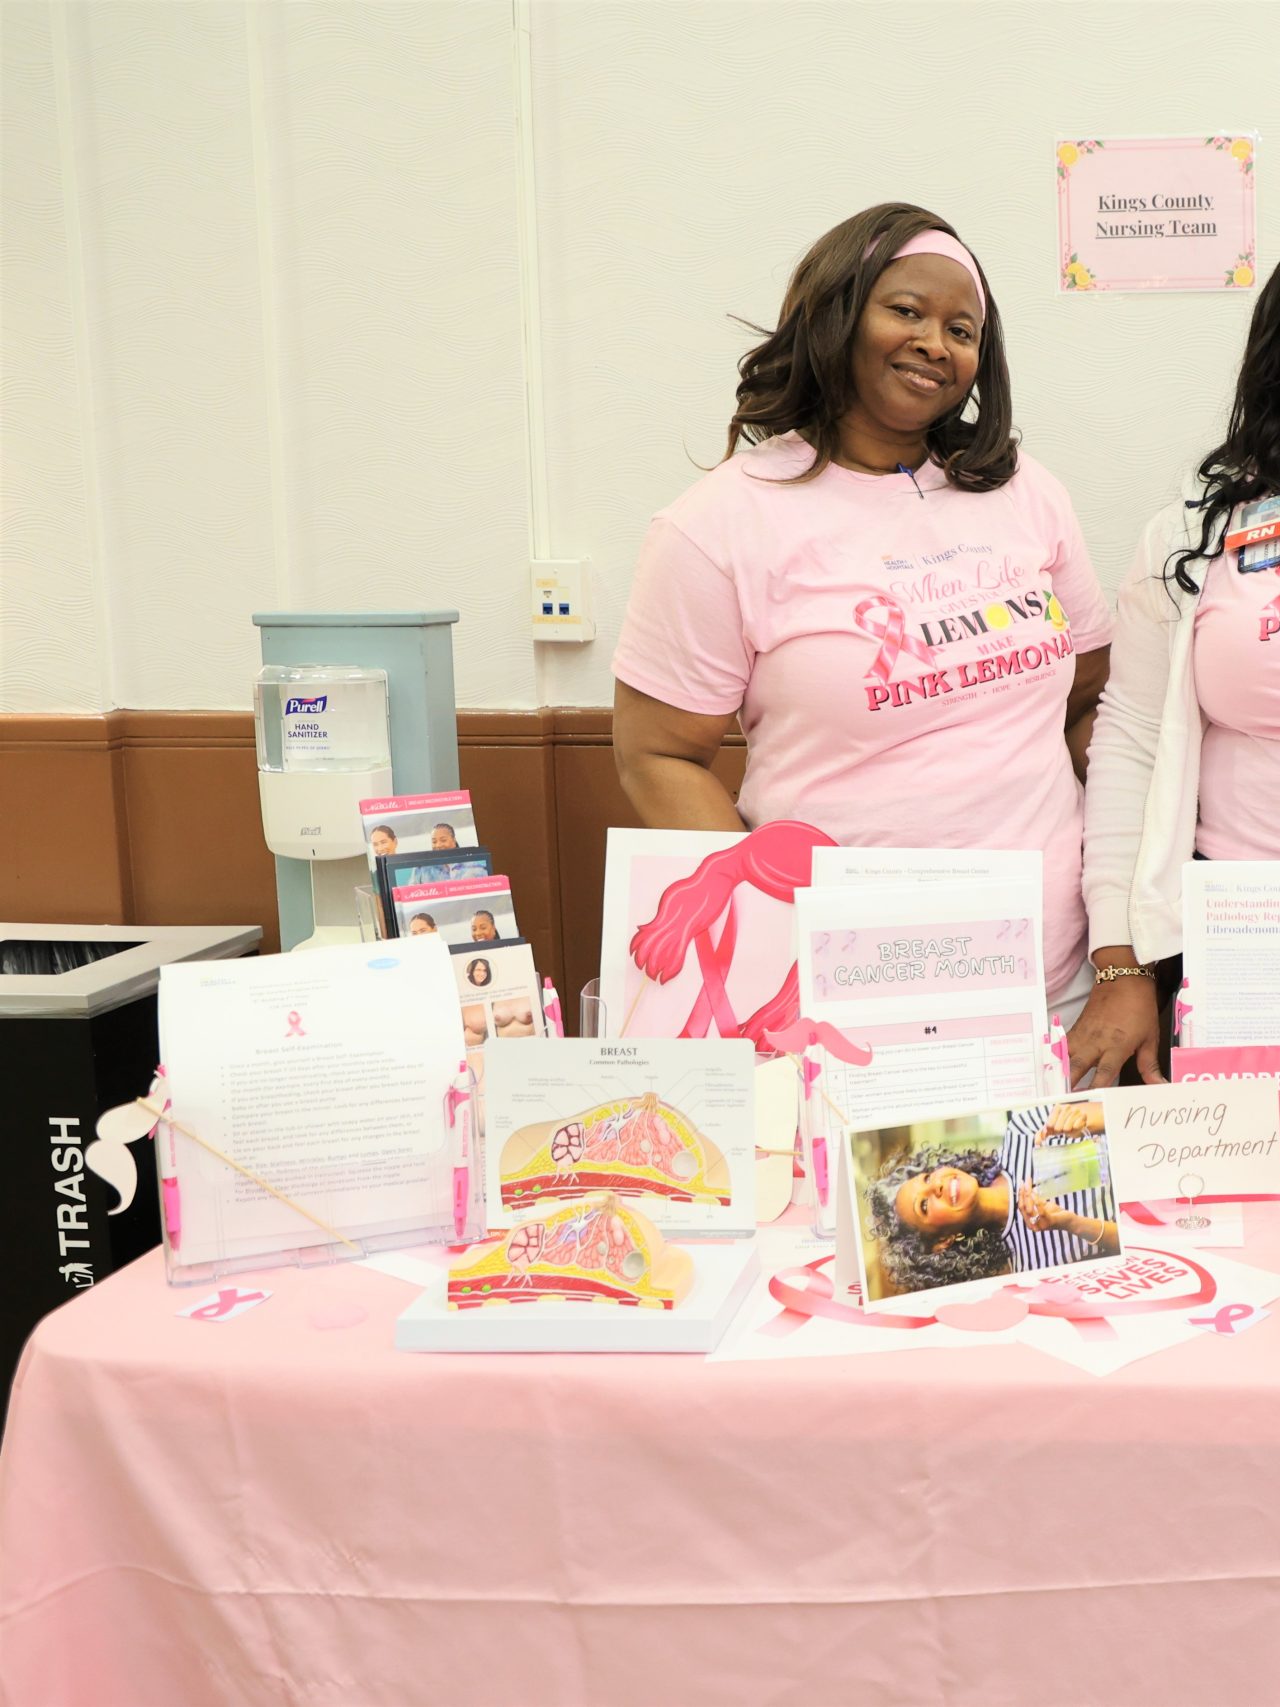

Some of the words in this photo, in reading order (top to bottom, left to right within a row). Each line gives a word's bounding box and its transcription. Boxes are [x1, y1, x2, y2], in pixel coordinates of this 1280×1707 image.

[1099, 195, 1147, 212] Kings
[1152, 193, 1214, 211] County
[1096, 220, 1164, 238] Nursing
[1169, 220, 1217, 236] Team
[1246, 525, 1275, 541] RN
[922, 548, 957, 565] Kings
[958, 543, 992, 555] County
[889, 572, 964, 603] When
[975, 555, 1025, 590] Life
[920, 591, 1043, 647] LEMONS
[977, 634, 1016, 656] MAKE
[864, 670, 953, 712] PINK
[957, 627, 1073, 688] LEMONA
[290, 699, 324, 713] Purell
[941, 692, 977, 707] STRENGTH
[992, 684, 1011, 694] HOPE
[1236, 884, 1262, 893] Kings
[1206, 911, 1262, 923] Pathology
[878, 937, 972, 961] BREAST
[834, 962, 926, 986] CANCER
[935, 955, 1015, 979] MONTH
[925, 1026, 937, 1035] #4
[600, 1048, 638, 1056] BREAST
[1137, 1131, 1278, 1168] Department
[48, 1117, 90, 1256] TRASH
[1077, 1258, 1167, 1294] SAVES
[1106, 1265, 1188, 1300] LIVES
